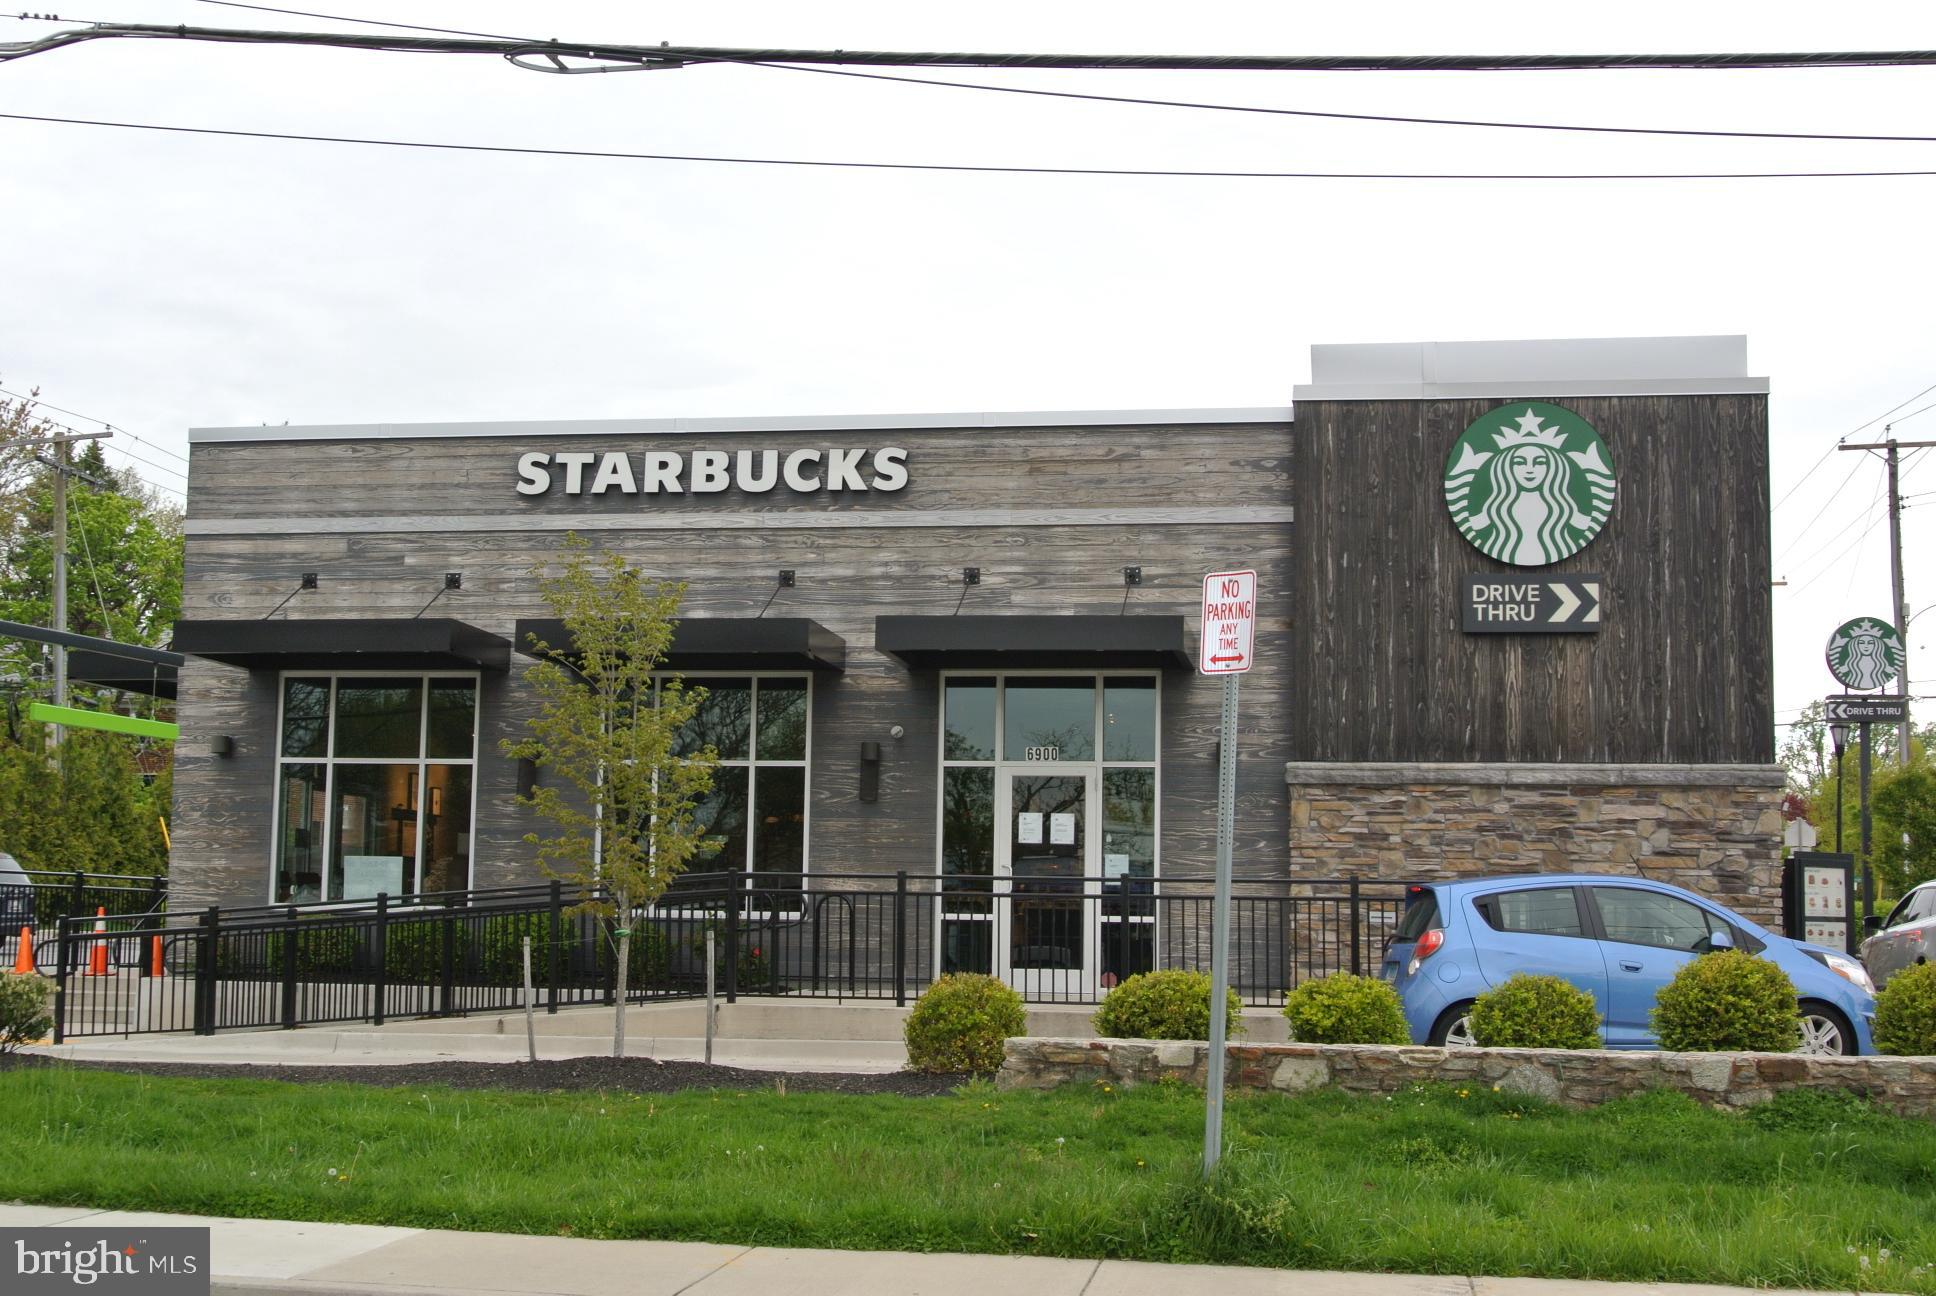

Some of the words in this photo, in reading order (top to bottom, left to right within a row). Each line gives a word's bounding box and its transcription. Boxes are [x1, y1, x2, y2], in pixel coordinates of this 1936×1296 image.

[516, 447, 909, 495] STARBUCKS
[1221, 580, 1240, 598] NO
[1472, 584, 1541, 602] DRIVE
[1207, 600, 1251, 621] PARKING
[1472, 603, 1536, 622] THRU
[1219, 623, 1239, 636] ANY
[1218, 637, 1239, 650] TIME
[1846, 707, 1875, 716] DRIVE
[1876, 707, 1902, 716] THRU
[1027, 747, 1058, 761] 6900
